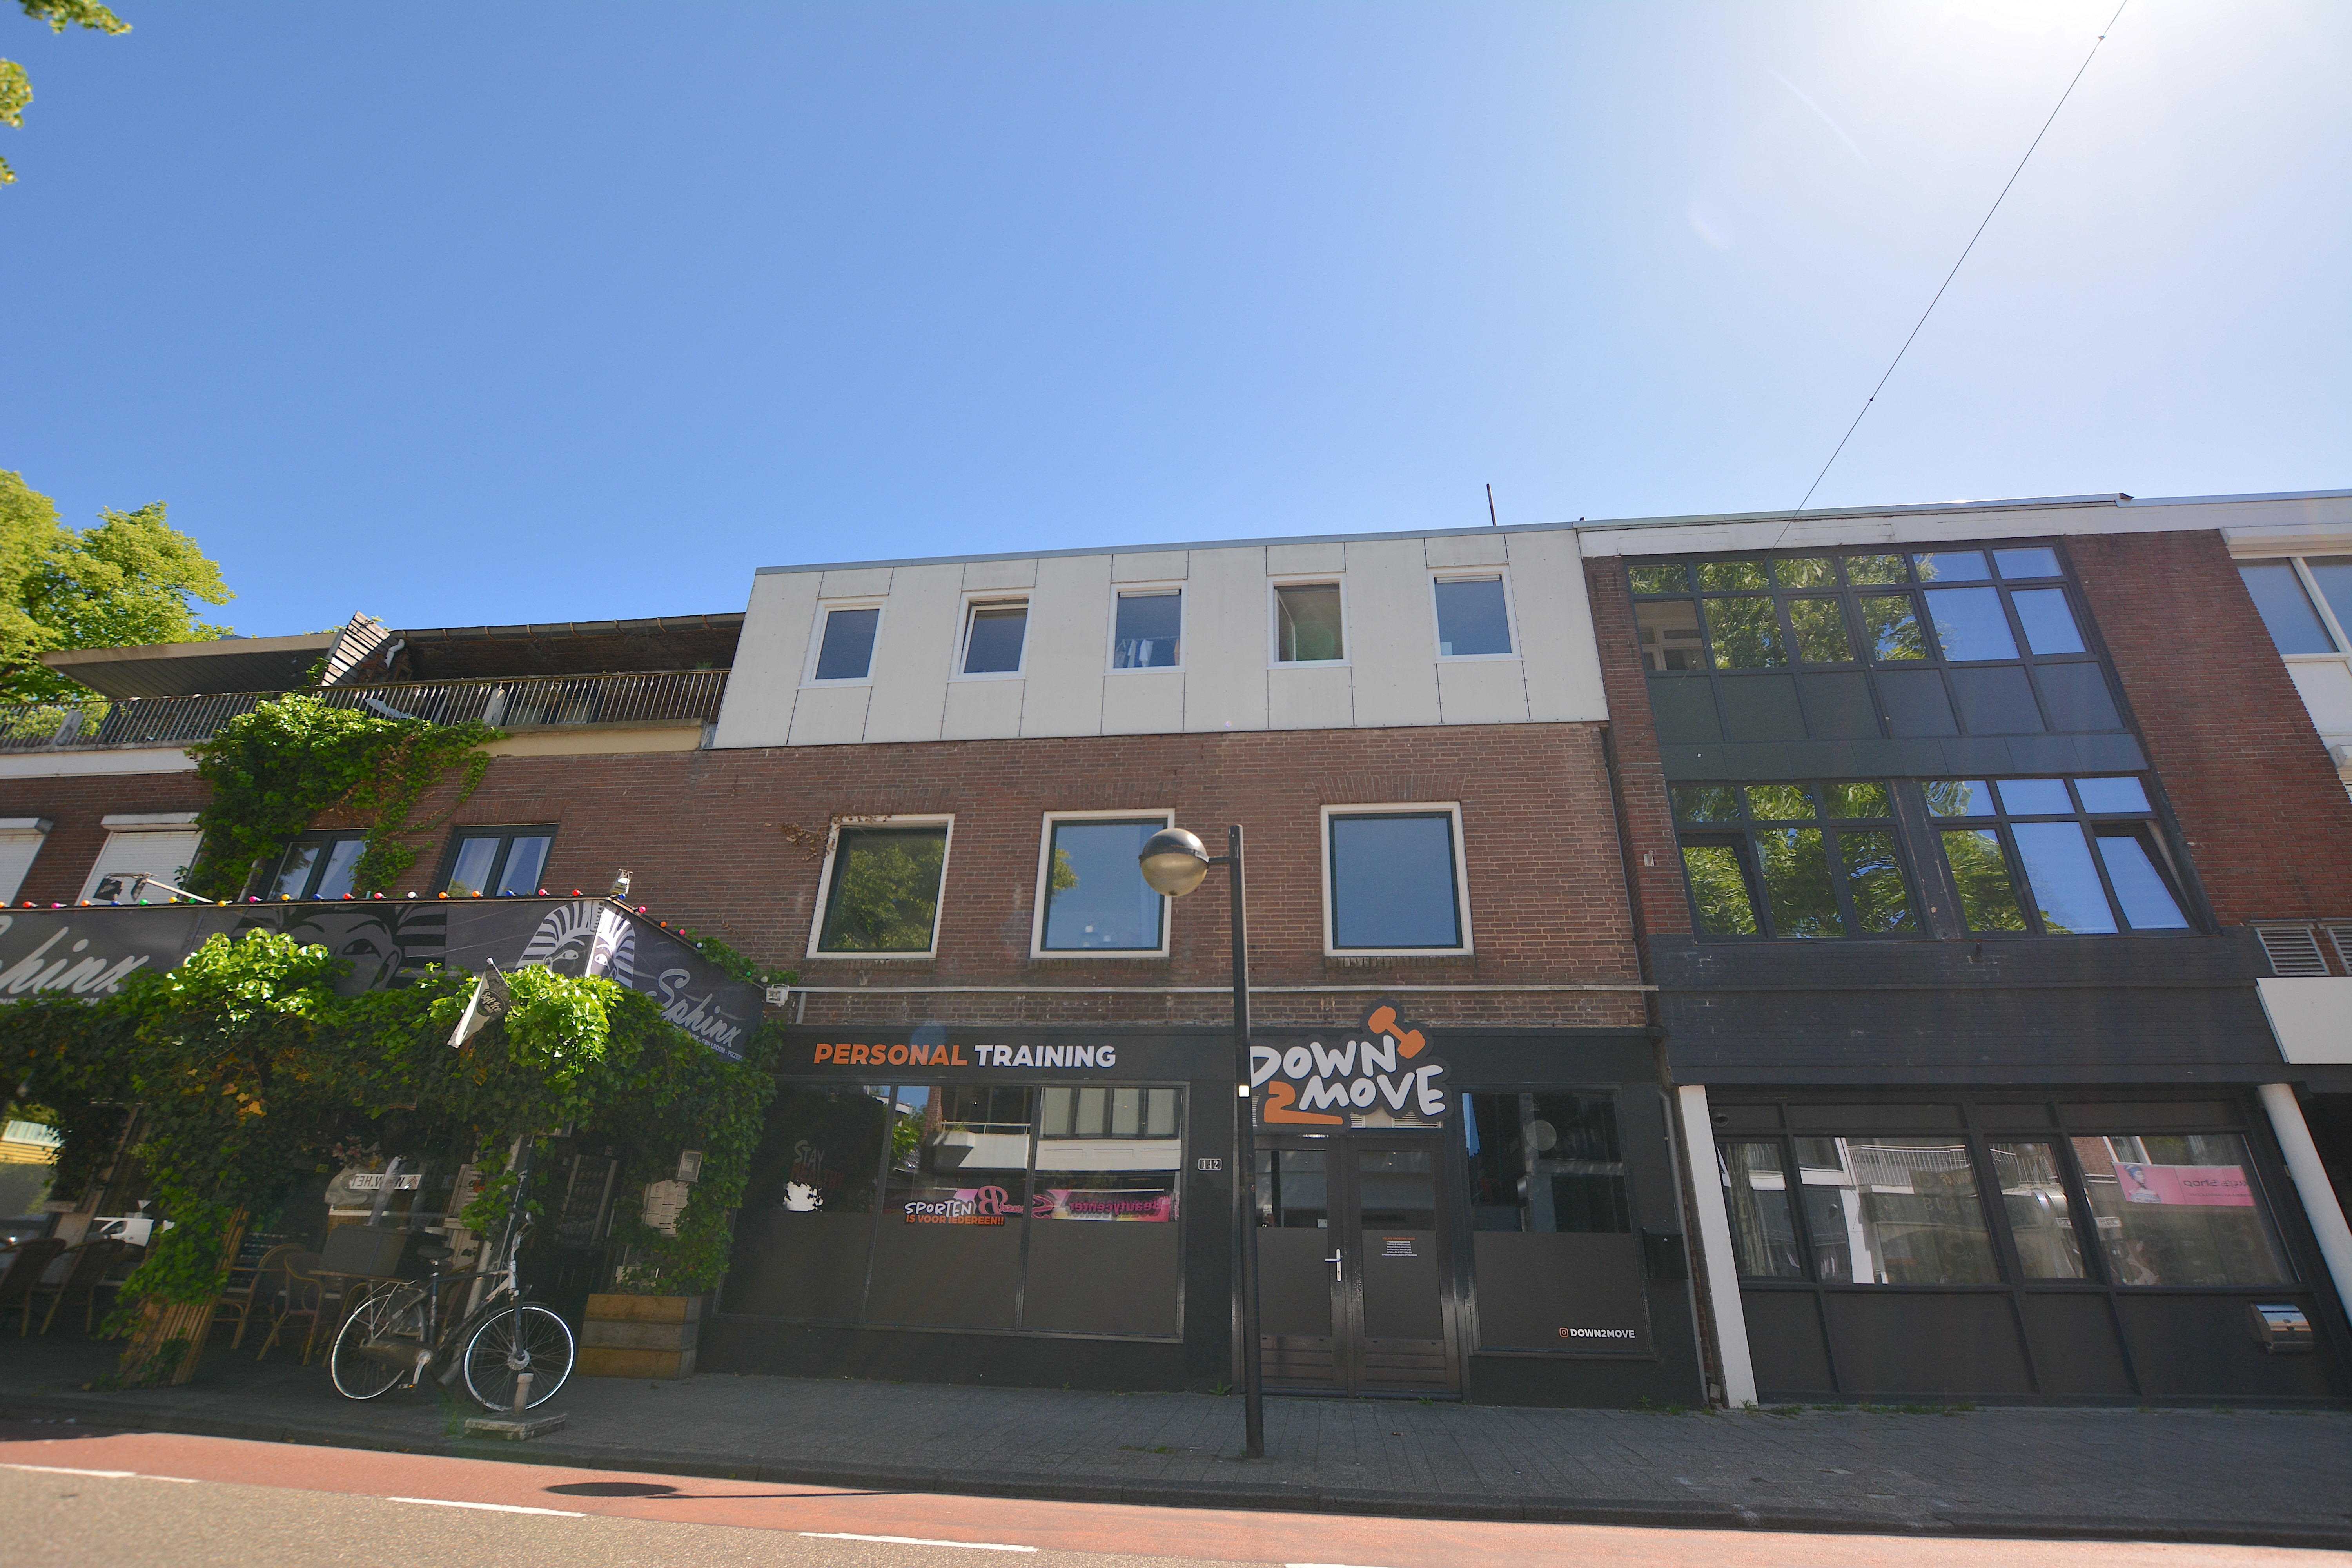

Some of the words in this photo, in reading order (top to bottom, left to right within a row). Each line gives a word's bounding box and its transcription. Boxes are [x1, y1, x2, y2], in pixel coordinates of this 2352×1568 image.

[0, 915, 150, 995] hinx
[481, 992, 496, 1004] Soft
[644, 968, 742, 1048] Sphinx
[813, 1044, 968, 1066] PERSONAL
[975, 1045, 1116, 1067] TRAINING
[1249, 1035, 1397, 1089] DOWN
[1298, 1064, 1446, 1116] MOVE
[1264, 1080, 1343, 1125] 2
[1203, 1160, 1218, 1169] 142
[904, 1200, 972, 1218] SPORTEN
[906, 1215, 915, 1223] IS
[918, 1215, 946, 1224] VOOR
[948, 1216, 1004, 1225] IEDEREEN!!
[1570, 1328, 1635, 1338] DOWN2MOVE
